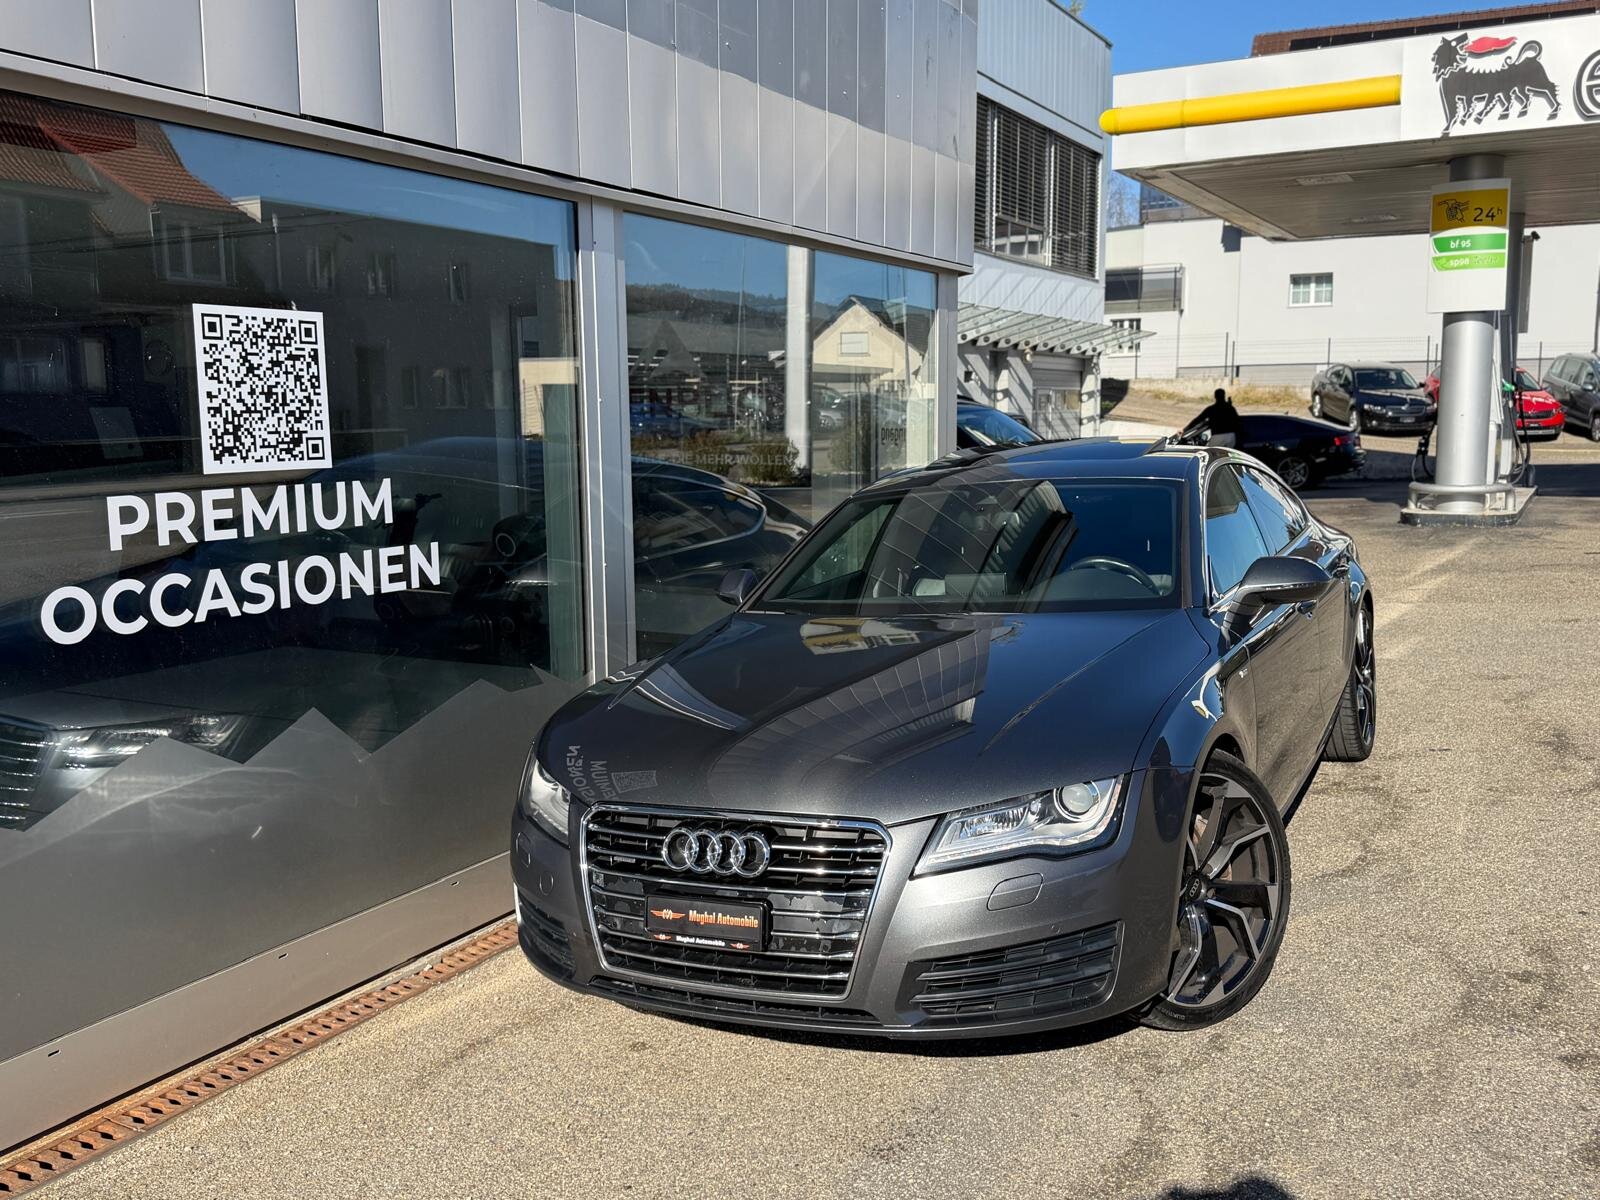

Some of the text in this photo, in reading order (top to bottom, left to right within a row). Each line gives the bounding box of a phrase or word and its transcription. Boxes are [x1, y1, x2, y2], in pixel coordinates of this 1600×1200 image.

[106, 478, 393, 551] PREMIUM
[40, 541, 441, 645] OCCASIONEN
[676, 935, 726, 948] Mughal Automobile
[688, 909, 759, 928] Mughal Automobile
